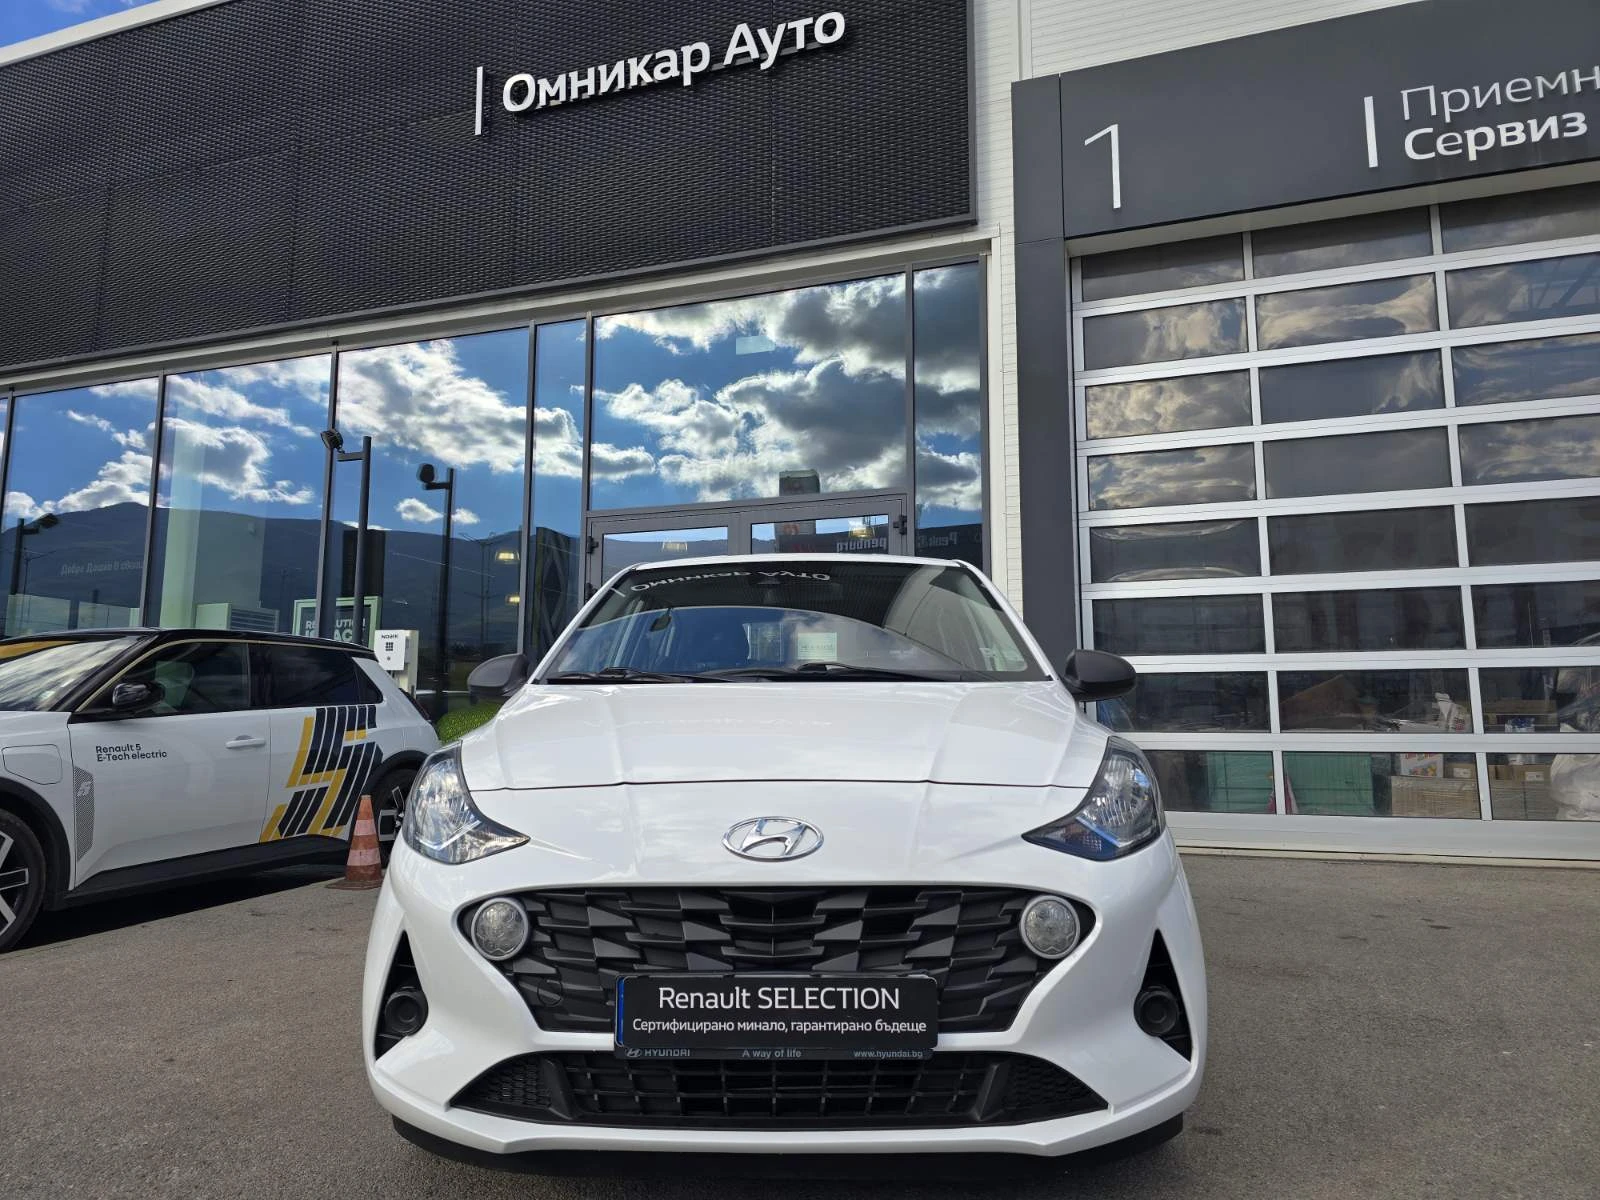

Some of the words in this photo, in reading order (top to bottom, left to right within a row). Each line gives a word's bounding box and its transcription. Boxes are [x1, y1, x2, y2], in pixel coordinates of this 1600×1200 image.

[502, 41, 710, 113] Омникар
[723, 11, 845, 71] Ауто
[1400, 65, 1600, 124] Приемн
[1404, 111, 1588, 161] Сервиз
[1084, 123, 1121, 209] 1
[96, 743, 134, 754] Renault
[135, 743, 142, 751] 5
[97, 752, 130, 762] E-Tech
[131, 749, 168, 760] electric
[658, 986, 751, 1009] Renault
[757, 986, 900, 1010] SELECTION
[632, 1017, 734, 1035] Сертифицирано
[737, 1020, 788, 1033] минало,
[790, 1020, 872, 1034] гарантирано
[874, 1017, 927, 1033] бъдеще
[644, 1049, 691, 1057] HYUNDAI
[774, 1049, 785, 1058] of
[786, 1048, 802, 1058] life
